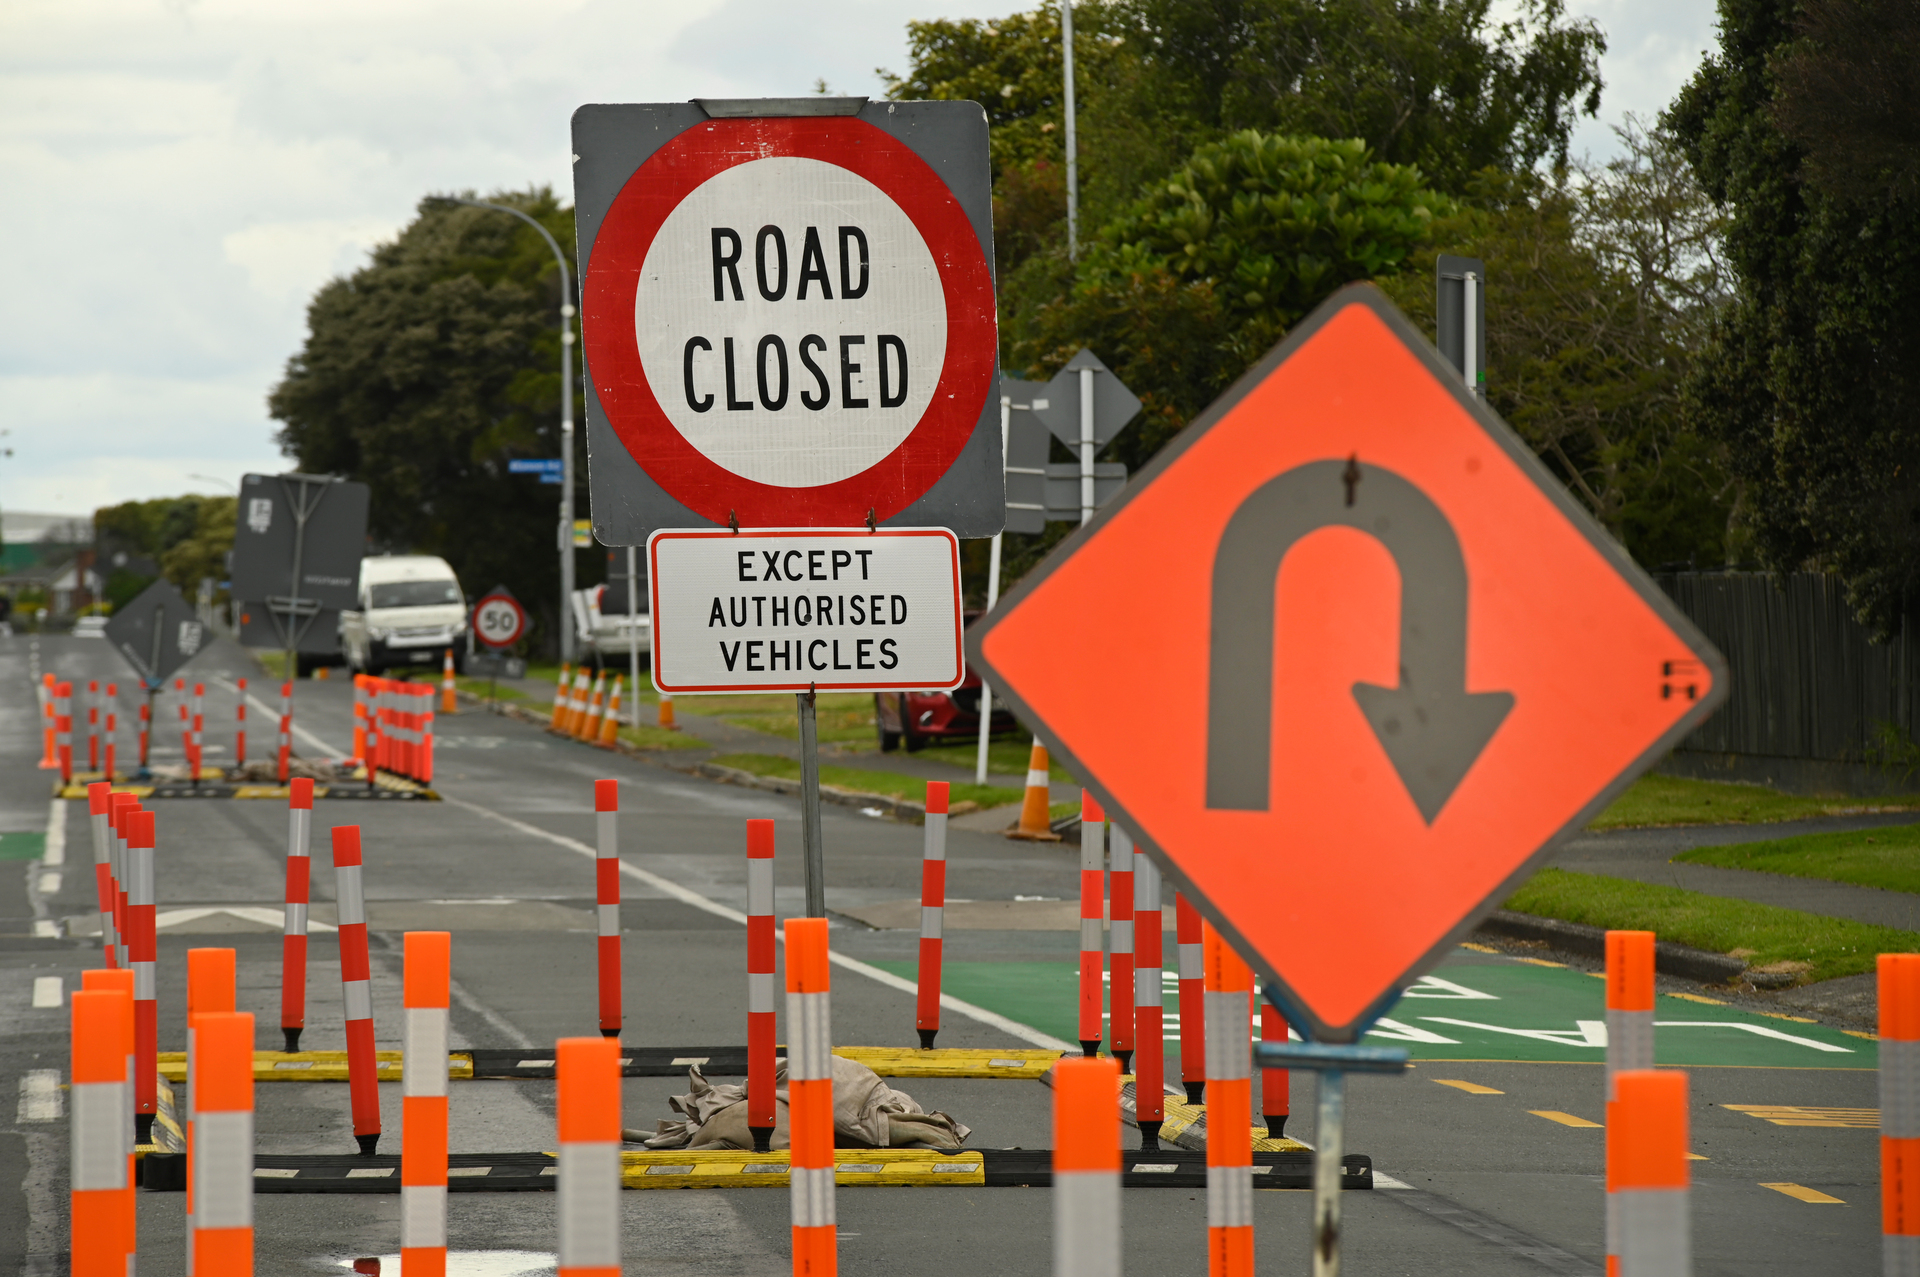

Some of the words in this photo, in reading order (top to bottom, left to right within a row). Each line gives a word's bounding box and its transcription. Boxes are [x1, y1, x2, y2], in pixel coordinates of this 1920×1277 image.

[712, 225, 869, 301] ROAD
[684, 334, 908, 413] CLOSED
[738, 550, 872, 581] EXCEPT
[484, 610, 514, 631] 50
[709, 595, 907, 627] AUTHORISED
[720, 639, 898, 671] VEHICLES
